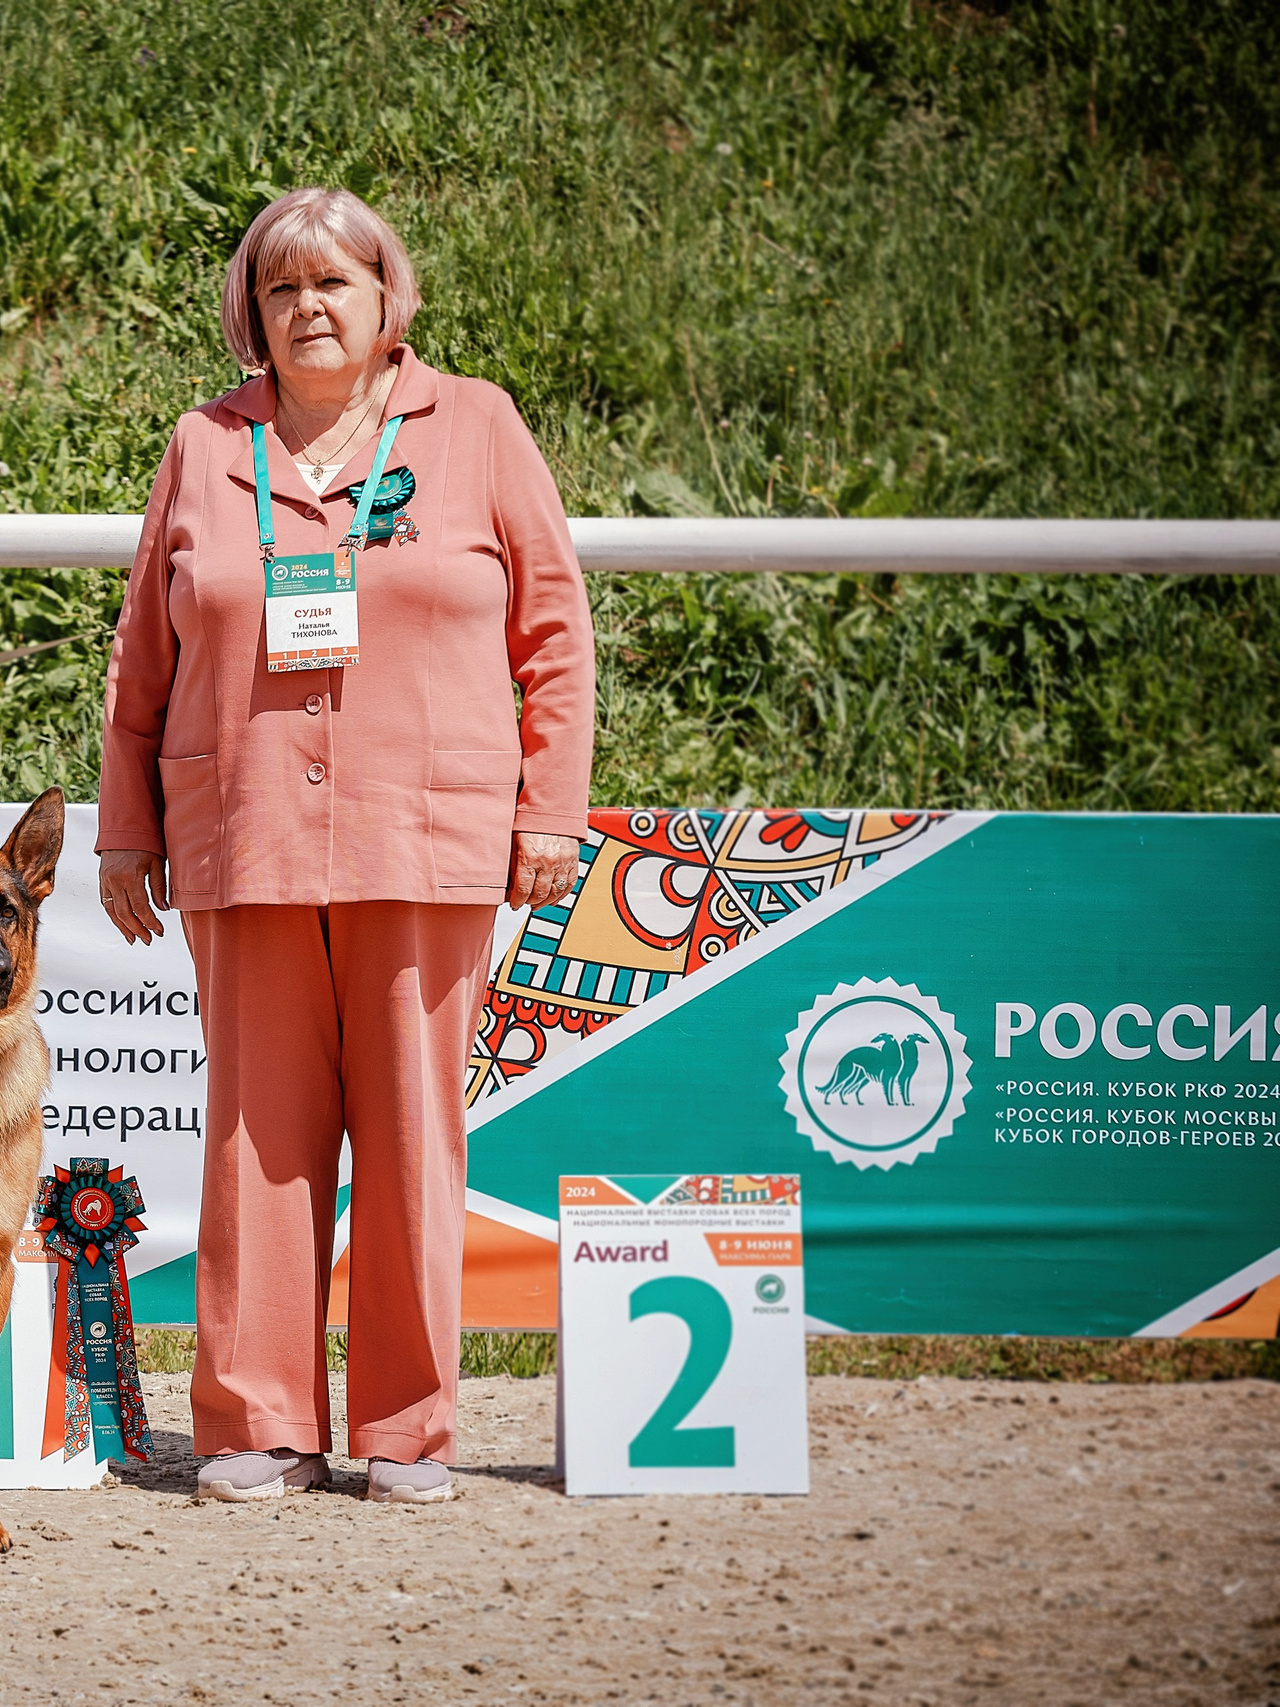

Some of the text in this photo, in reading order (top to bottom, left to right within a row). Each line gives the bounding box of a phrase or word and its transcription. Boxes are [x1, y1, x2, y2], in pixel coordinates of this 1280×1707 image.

[291, 569, 329, 579] РОССИЯ
[294, 607, 332, 618] СУДЬЯ
[298, 622, 330, 630] Наталья
[291, 629, 338, 639] ТИХОНОВА
[36, 980, 199, 1016] оссийс
[995, 1002, 1280, 1062] РОССИ
[49, 1047, 207, 1074] нологи
[995, 1080, 1100, 1097] «РОССИЯ.
[1108, 1081, 1177, 1098] КУБОК
[1185, 1083, 1227, 1099] РКФ
[995, 1107, 1276, 1126] «РОССИЯ. КУБОК МОСКВЫ
[42, 1103, 207, 1143] едерац
[995, 1128, 1064, 1144] КУБОК
[1072, 1129, 1256, 1148] ГОРОДОВ-ГЕРОЕВ
[565, 1187, 596, 1198] 2024
[758, 1209, 792, 1217] ПОРОД
[573, 1239, 669, 1263] Award
[746, 1239, 793, 1251] ИЮНЯ
[18, 1249, 59, 1258] МАКСИМ
[752, 1306, 790, 1315] РОССИЯ
[86, 1338, 113, 1346] РОССИЯ
[628, 1275, 736, 1468] 2
